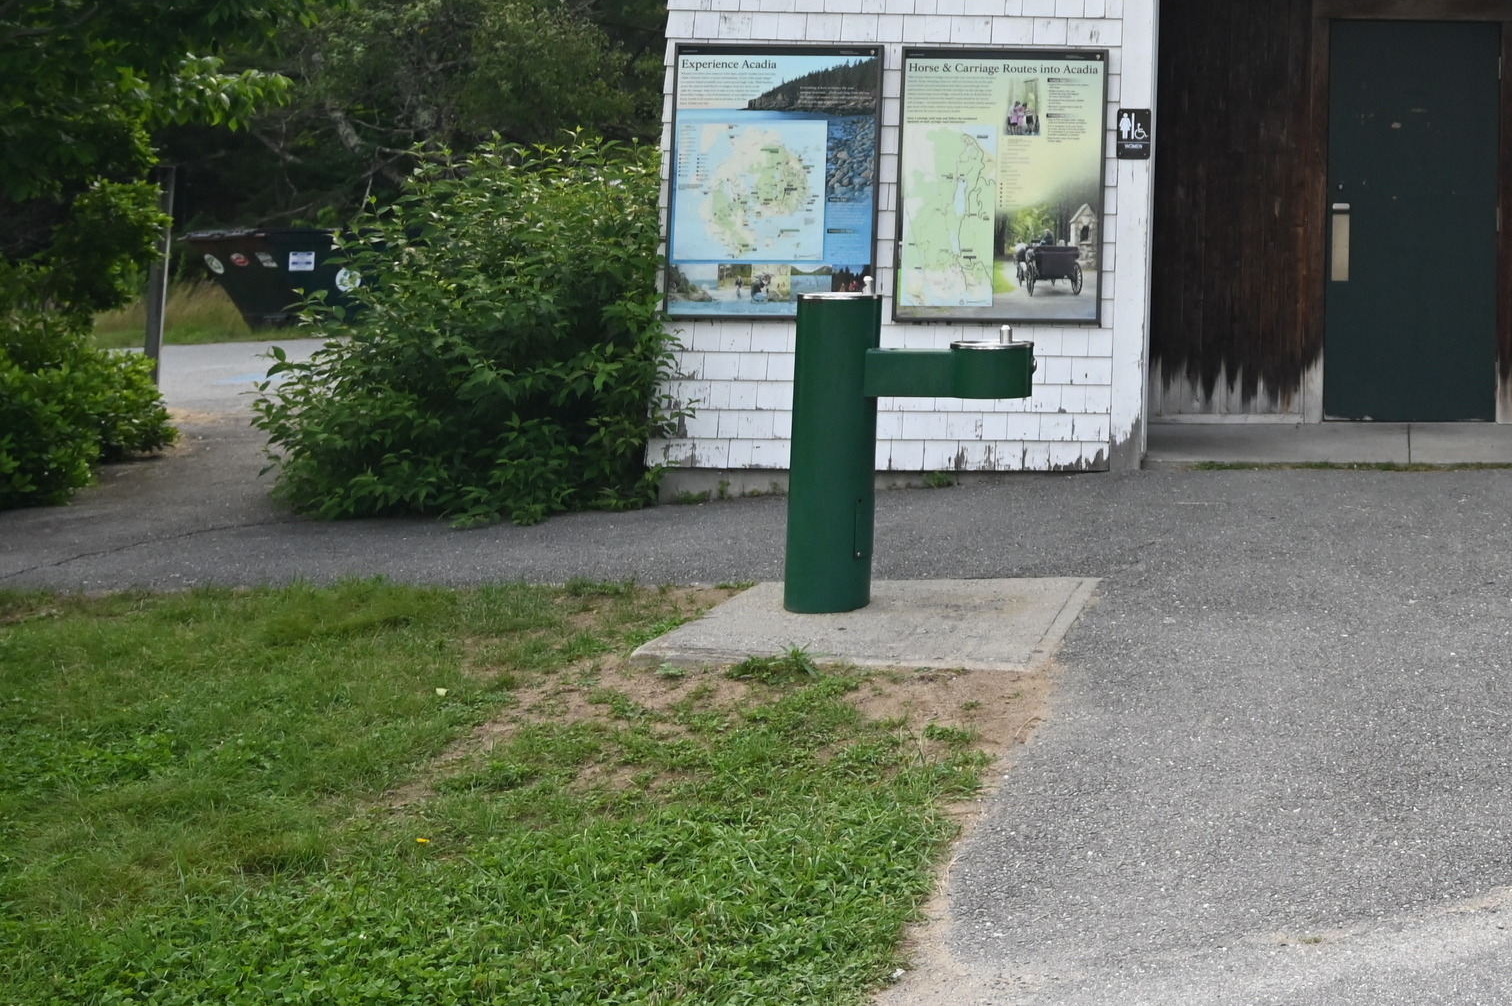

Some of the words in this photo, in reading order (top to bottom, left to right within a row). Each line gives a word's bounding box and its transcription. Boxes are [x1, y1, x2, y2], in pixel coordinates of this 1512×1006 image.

[681, 59, 739, 71] Experience
[741, 59, 777, 69] Acadia
[908, 62, 940, 73] Horse
[942, 63, 951, 73] &
[955, 63, 1000, 76] Carriage
[1003, 63, 1037, 74] Routes
[1040, 63, 1061, 75] into
[1063, 64, 1098, 75] Acadia
